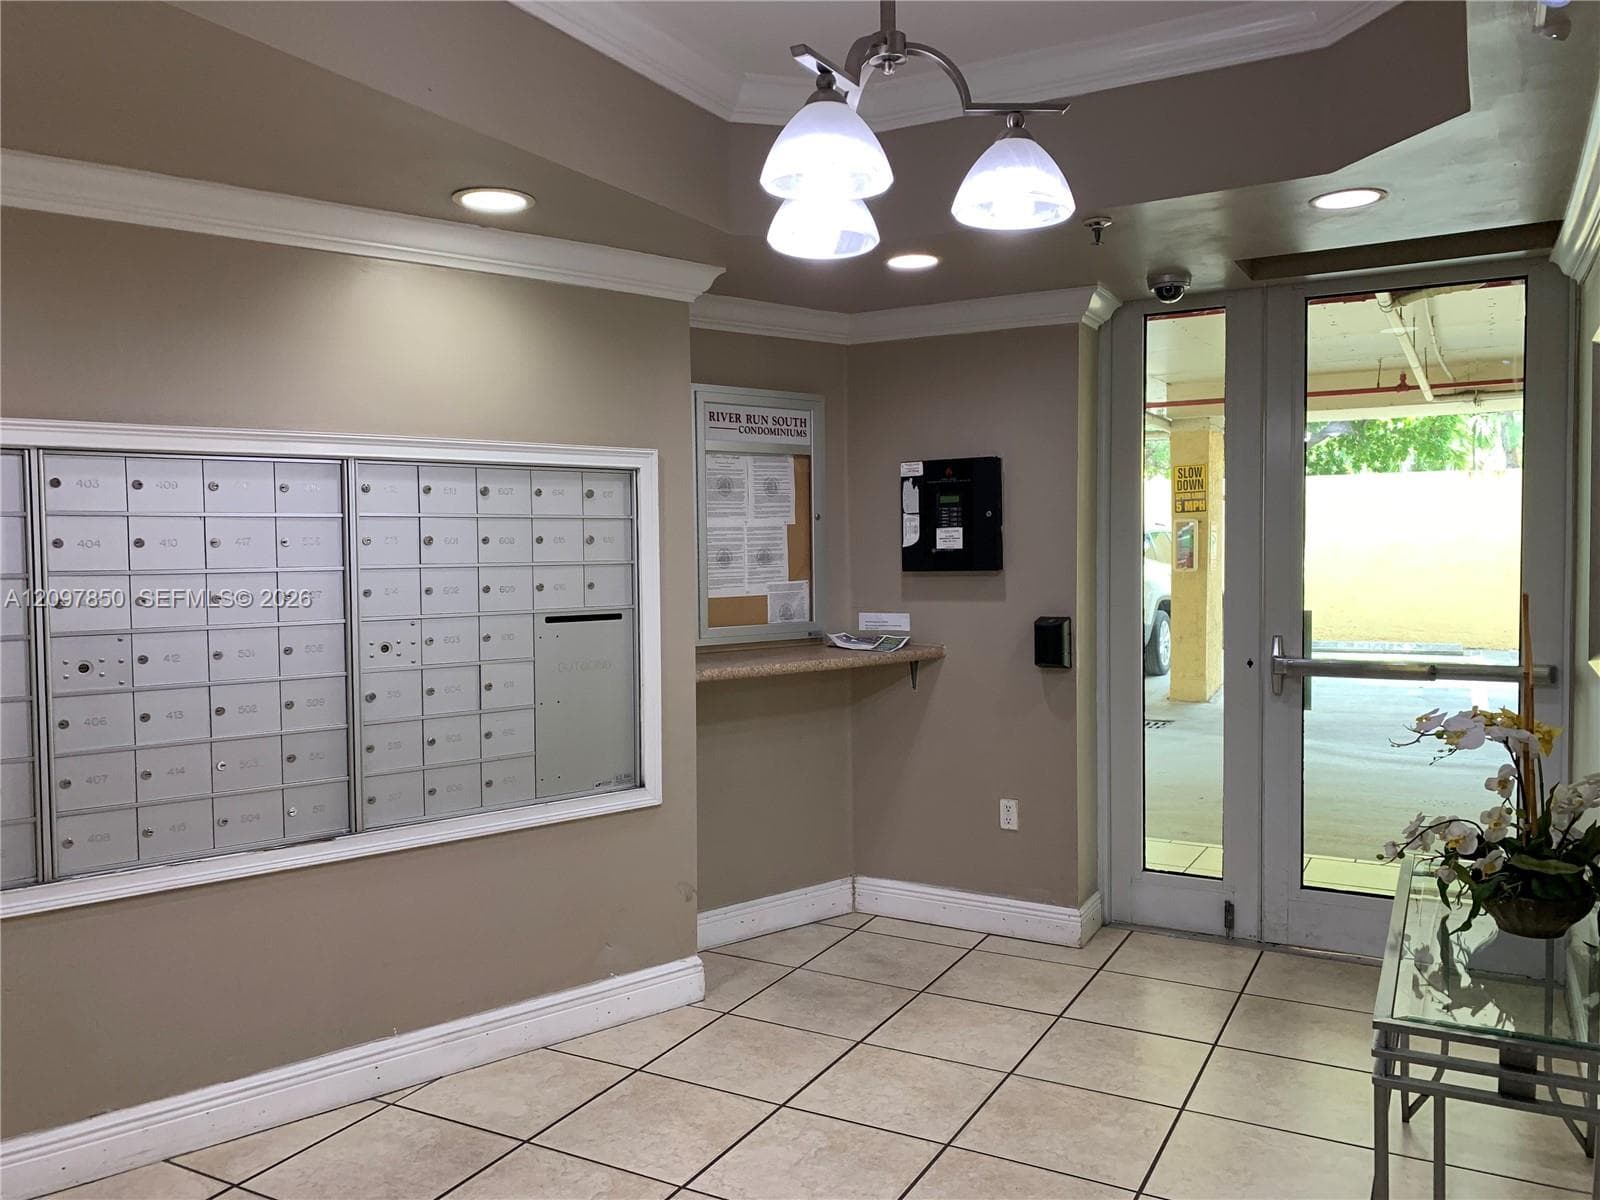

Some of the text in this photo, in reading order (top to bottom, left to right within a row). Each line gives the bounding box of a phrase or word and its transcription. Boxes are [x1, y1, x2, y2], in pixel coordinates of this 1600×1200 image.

[708, 411, 807, 428] RIVER RUN SOUTH
[738, 425, 807, 438] CONDOMINIUMS
[1177, 467, 1203, 479] SLOW
[1176, 479, 1204, 491] DOWN
[1176, 500, 1206, 511] 5 MPH
[76, 538, 101, 549] 404
[166, 711, 185, 720] 413
[83, 717, 108, 728] 406
[85, 775, 109, 785] 407
